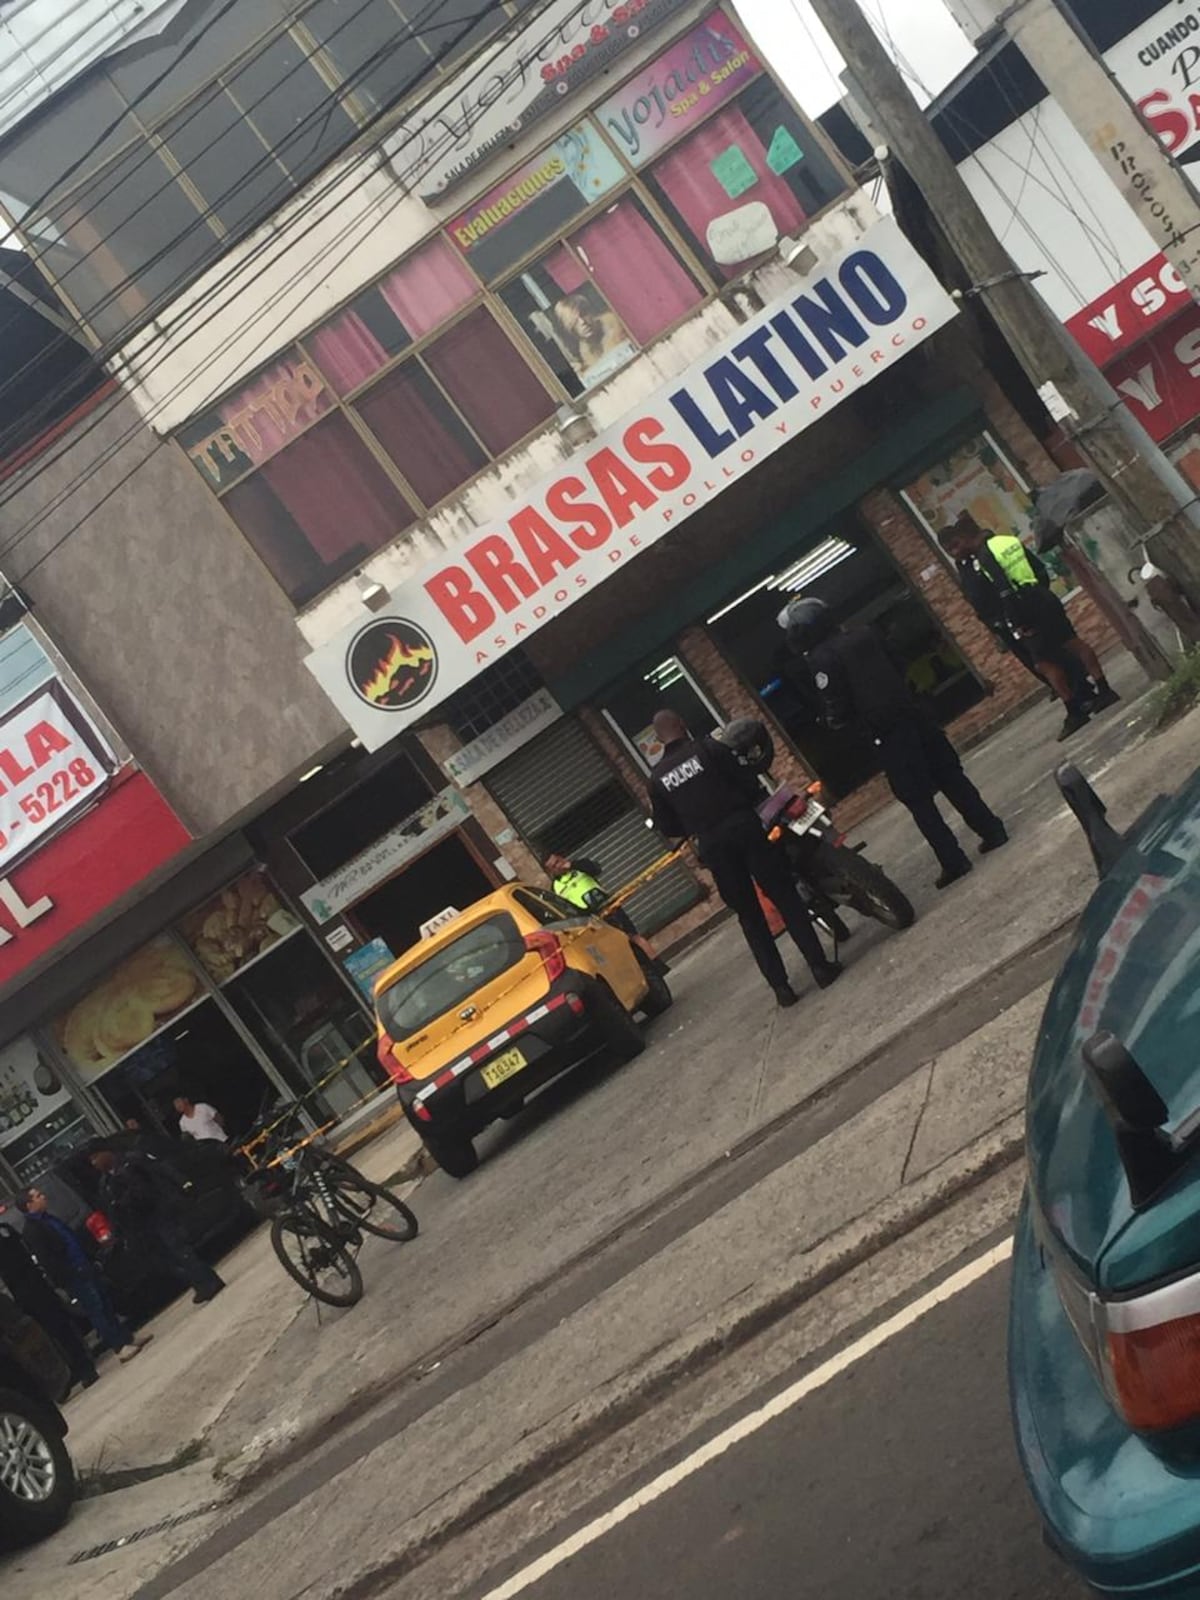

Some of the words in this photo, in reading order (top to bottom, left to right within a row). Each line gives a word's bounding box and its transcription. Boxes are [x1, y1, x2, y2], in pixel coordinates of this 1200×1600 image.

[590, 24, 609, 45] &
[1137, 14, 1199, 67] CUANDO
[670, 93, 698, 118] Spa
[698, 81, 711, 95] &
[711, 51, 749, 84] Salon
[454, 155, 566, 248] Evaluaciones
[1087, 303, 1123, 340] Y
[1116, 362, 1163, 411] Y
[423, 416, 692, 645] BRASAS
[669, 250, 907, 459] LATINO
[475, 575, 587, 664] ASADOS
[609, 534, 641, 565] DE
[662, 447, 756, 523] POLLO
[775, 421, 788, 435] Y
[810, 315, 928, 410] PUERCO
[661, 755, 704, 792] POLICIA
[425, 910, 454, 937] TAXI
